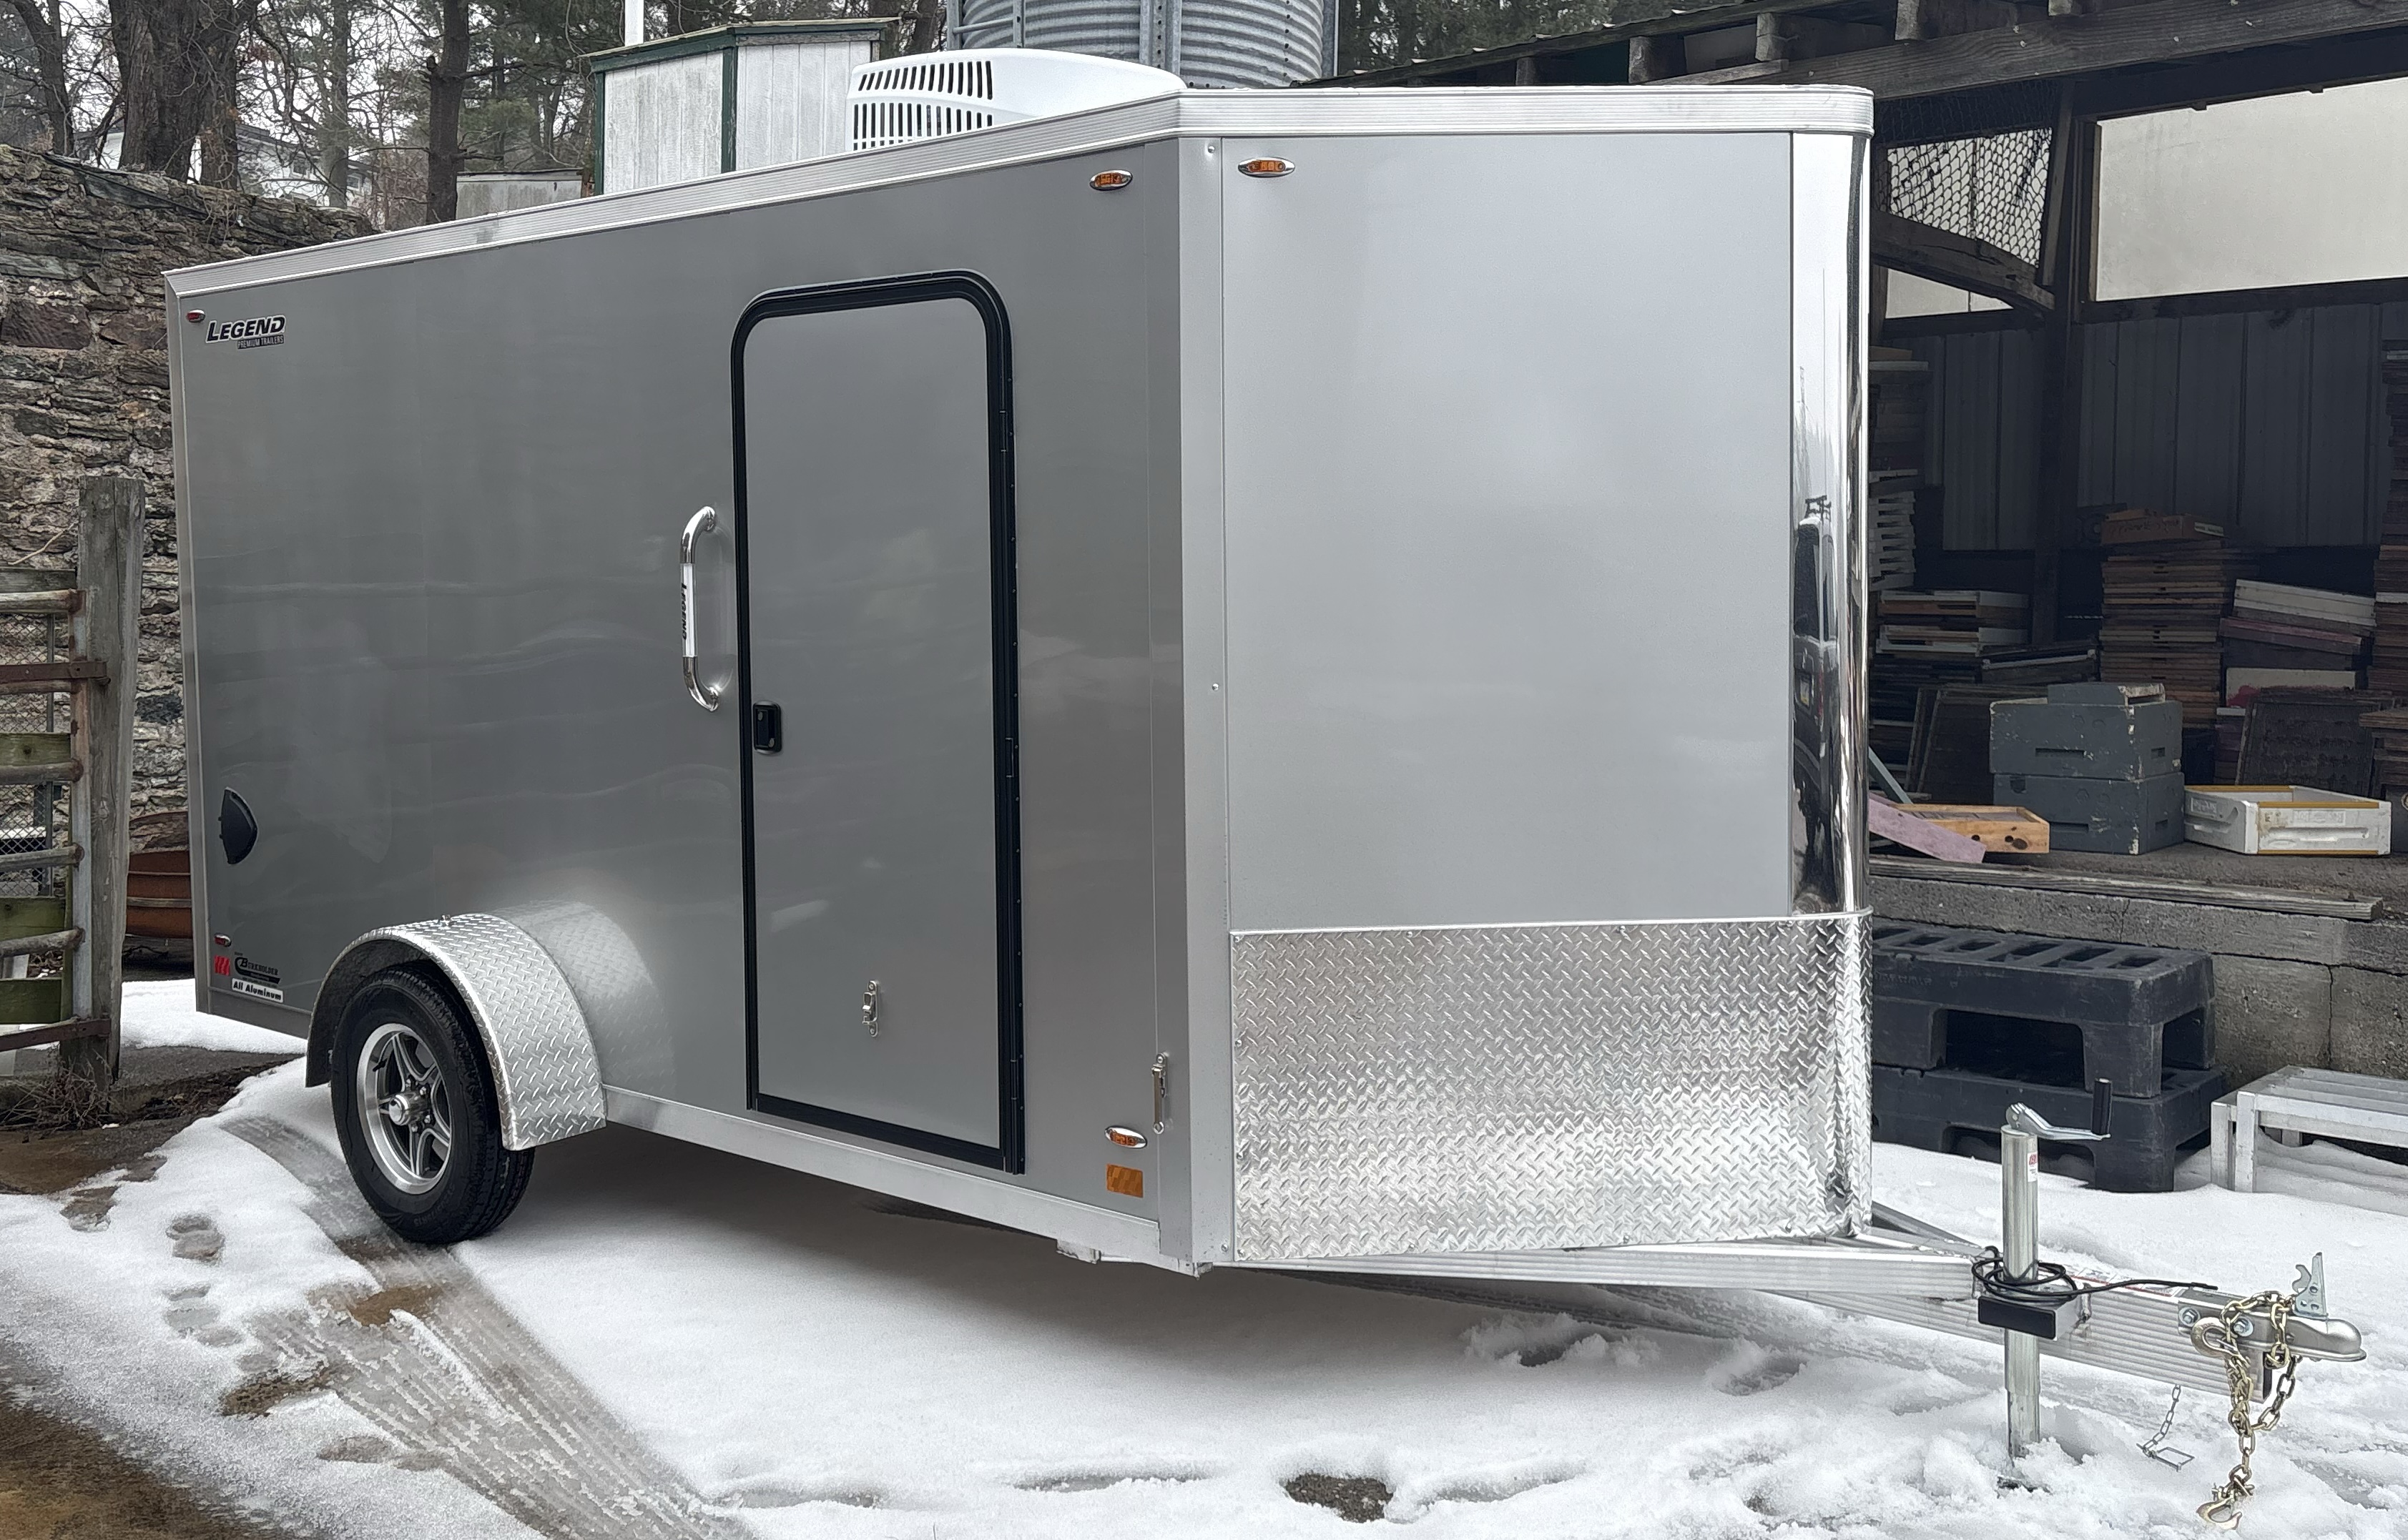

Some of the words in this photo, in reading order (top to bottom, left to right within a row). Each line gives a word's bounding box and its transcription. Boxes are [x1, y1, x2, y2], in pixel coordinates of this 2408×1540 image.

[207, 316, 285, 342] LEGEND
[237, 338, 260, 348] PREMIUM
[260, 335, 284, 345] TRAILERS
[233, 980, 243, 991] All
[245, 984, 282, 1001] Aluminum
